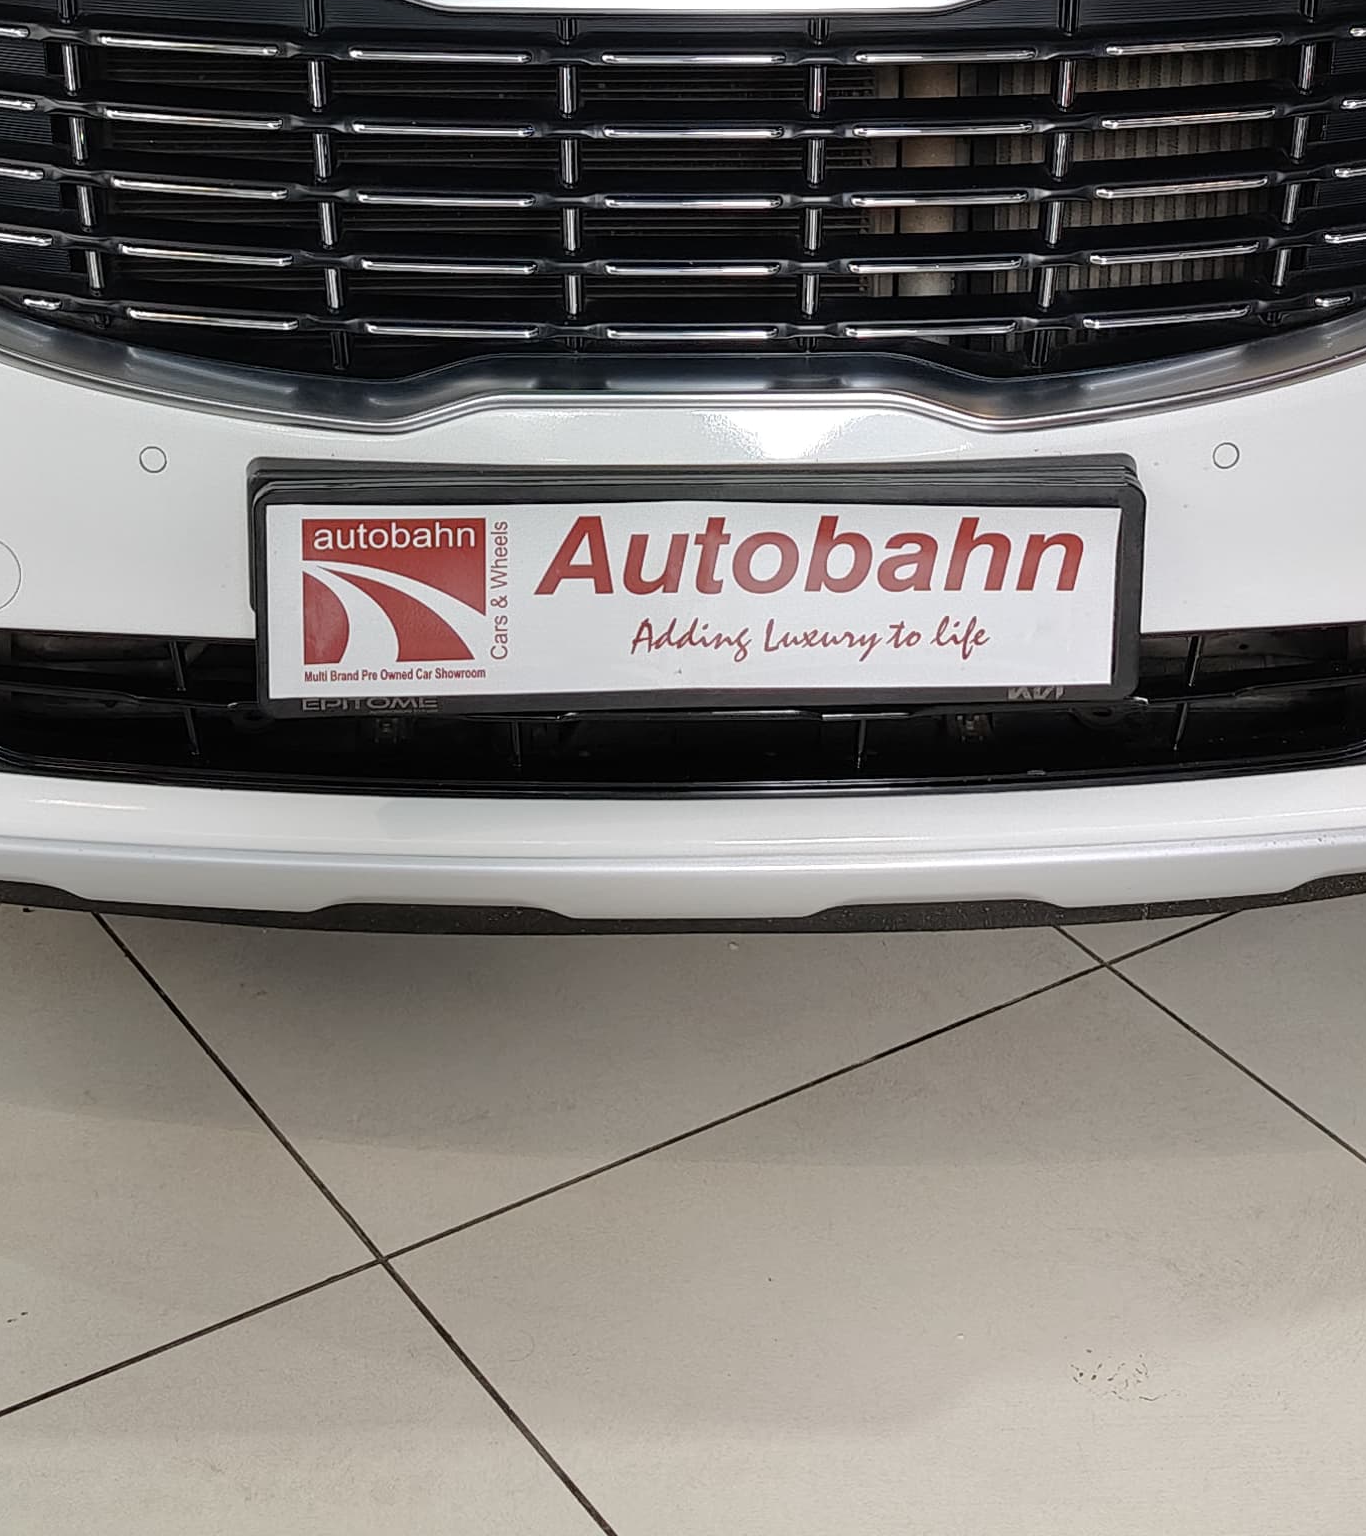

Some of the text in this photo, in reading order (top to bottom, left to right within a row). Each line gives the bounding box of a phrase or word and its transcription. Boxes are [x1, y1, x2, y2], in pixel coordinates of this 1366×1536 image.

[313, 521, 476, 550] autobahn
[534, 514, 1086, 596] Autobahn
[490, 520, 509, 661] Cars & Wheels
[630, 615, 990, 662] Adding Luxury to life
[304, 667, 487, 683] Multi Brand Pre Owned Car Showroom
[302, 696, 438, 711] EPITOME
